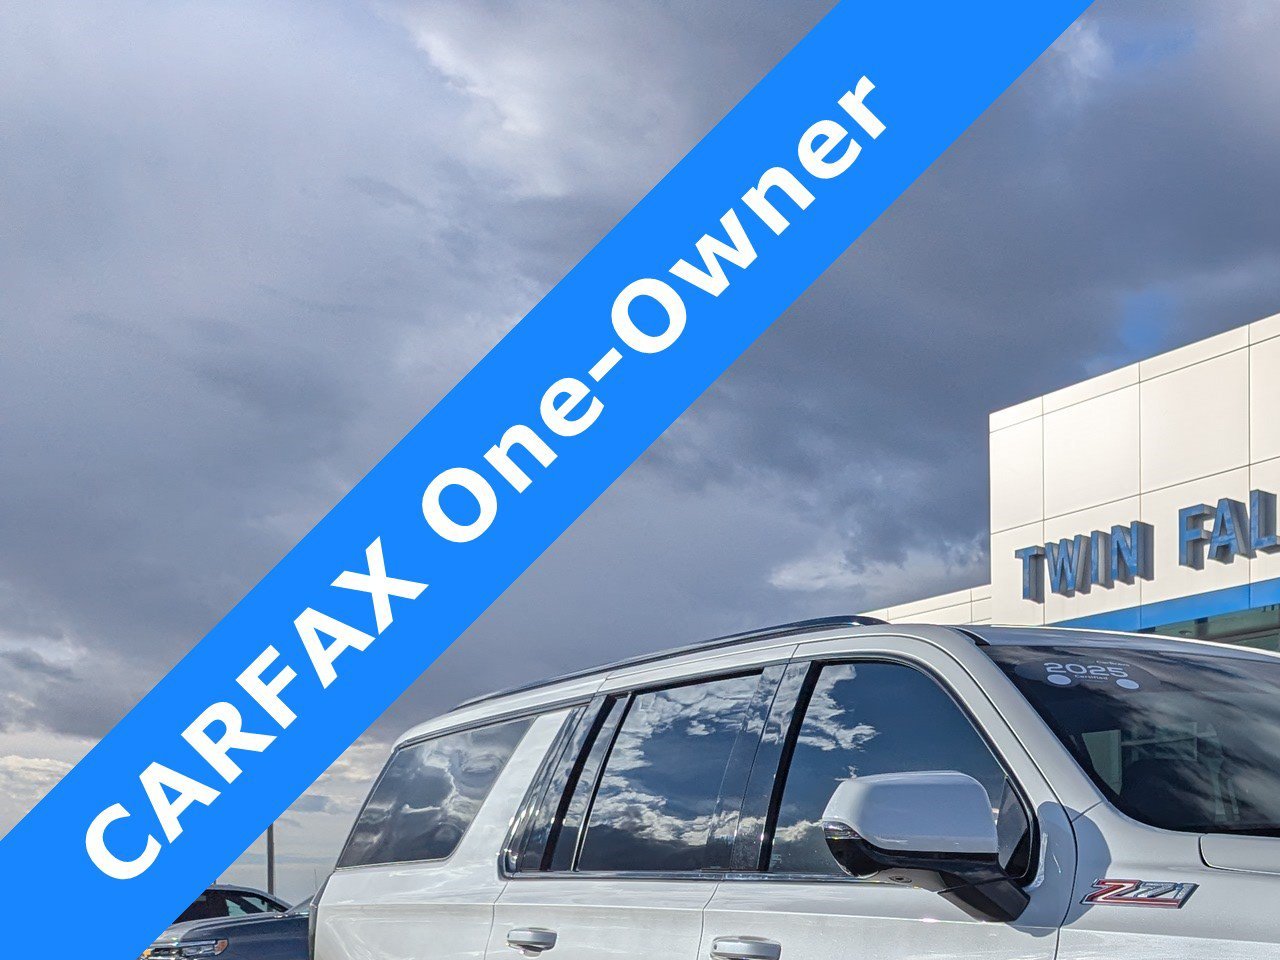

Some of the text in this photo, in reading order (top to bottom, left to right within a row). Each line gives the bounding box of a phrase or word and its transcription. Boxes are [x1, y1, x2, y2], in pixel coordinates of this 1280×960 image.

[1014, 519, 1155, 604] TWIN
[1043, 662, 1129, 678] 2025
[1080, 879, 1200, 909] Z71
